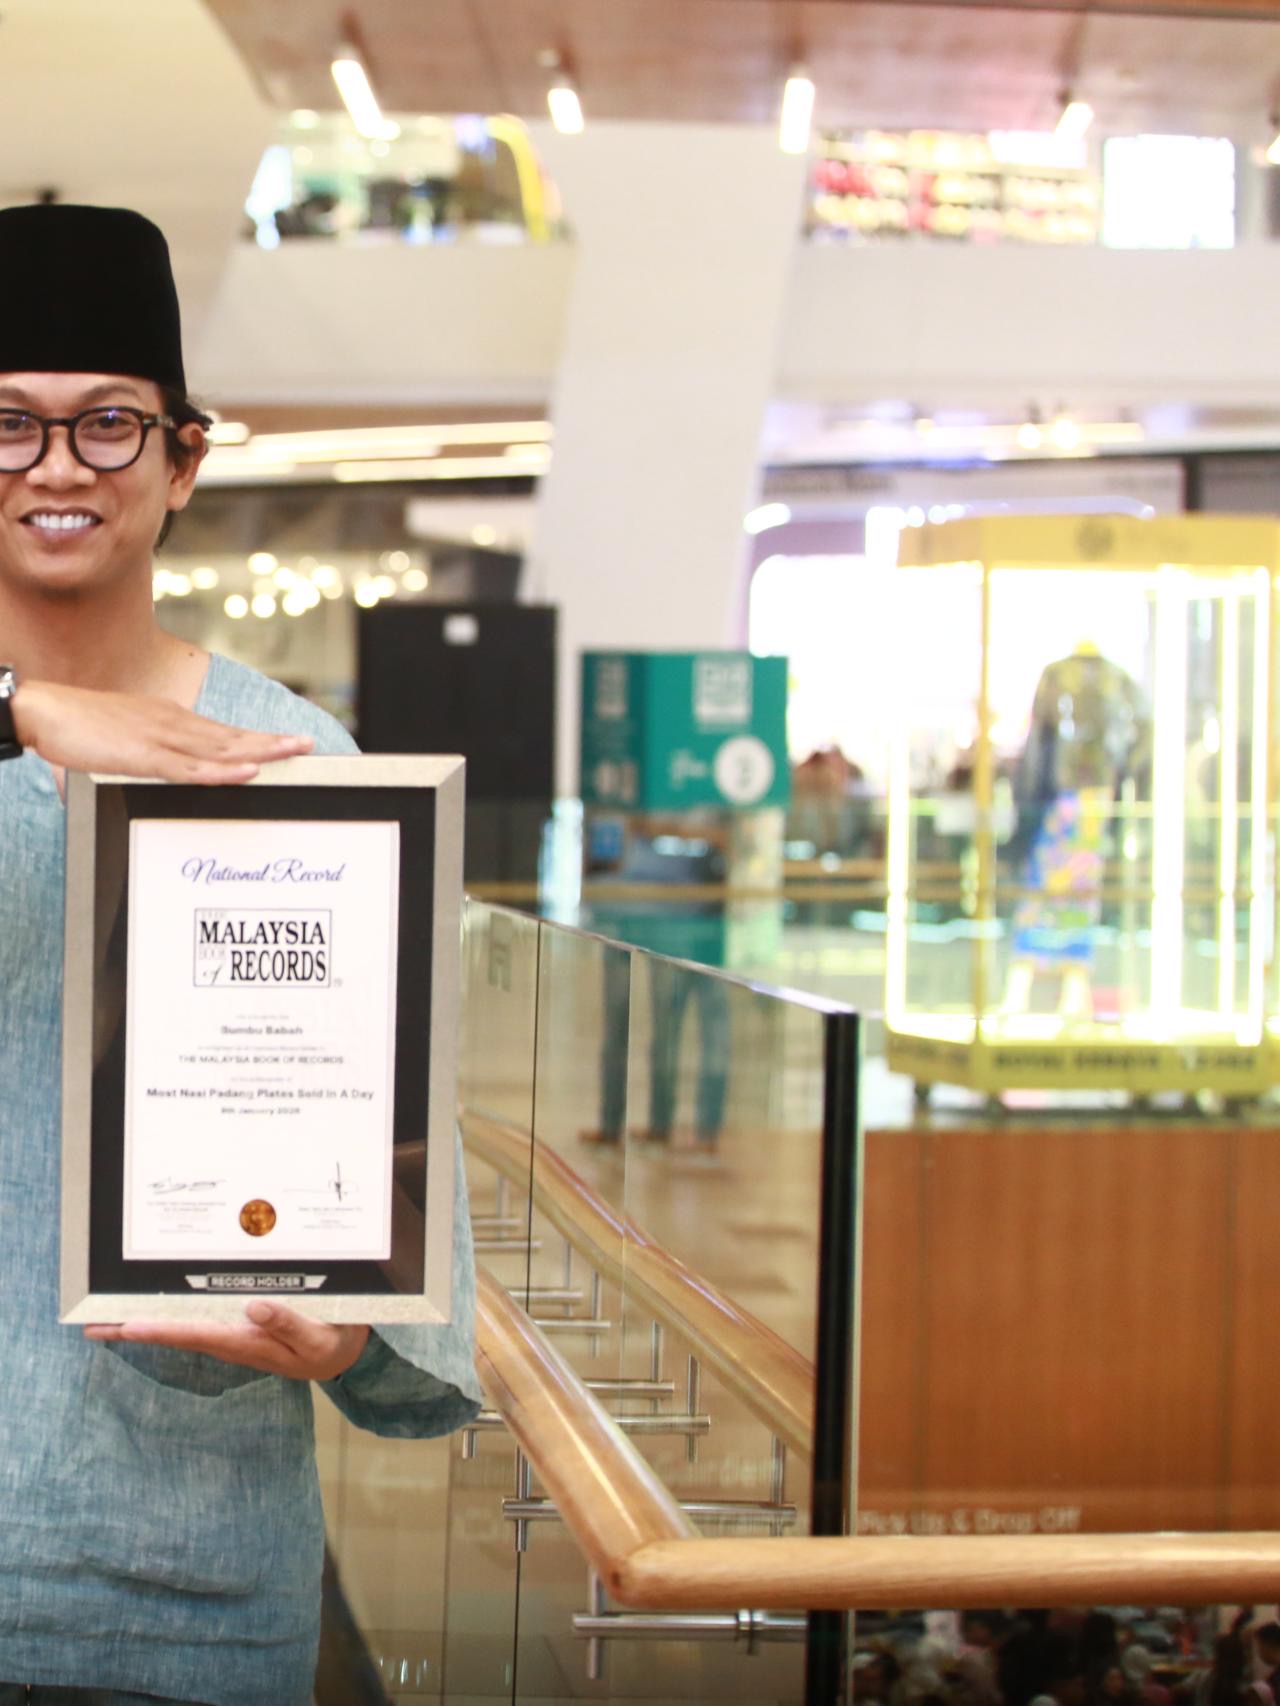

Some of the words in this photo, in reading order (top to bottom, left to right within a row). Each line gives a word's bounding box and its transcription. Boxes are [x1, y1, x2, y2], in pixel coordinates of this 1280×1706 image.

[181, 857, 270, 885] National
[271, 858, 346, 884] Record
[199, 920, 326, 945] MALAYSIA
[230, 950, 327, 982] RECORDS
[220, 1024, 263, 1036] Sumbu
[178, 1055, 197, 1065] THE
[199, 1055, 251, 1065] MALAYSIA
[252, 1055, 281, 1065] BOOK
[283, 1055, 295, 1065] OF
[297, 1055, 345, 1065] RECORDS
[146, 1087, 177, 1098] Most
[179, 1087, 206, 1098] Nasi
[209, 1087, 254, 1101] Padang
[256, 1087, 294, 1099] Plates
[297, 1087, 324, 1099] Sold
[339, 1088, 349, 1099] A
[351, 1088, 375, 1101] Day
[211, 1275, 255, 1288] RECORD
[257, 1275, 301, 1288] HOLDER
